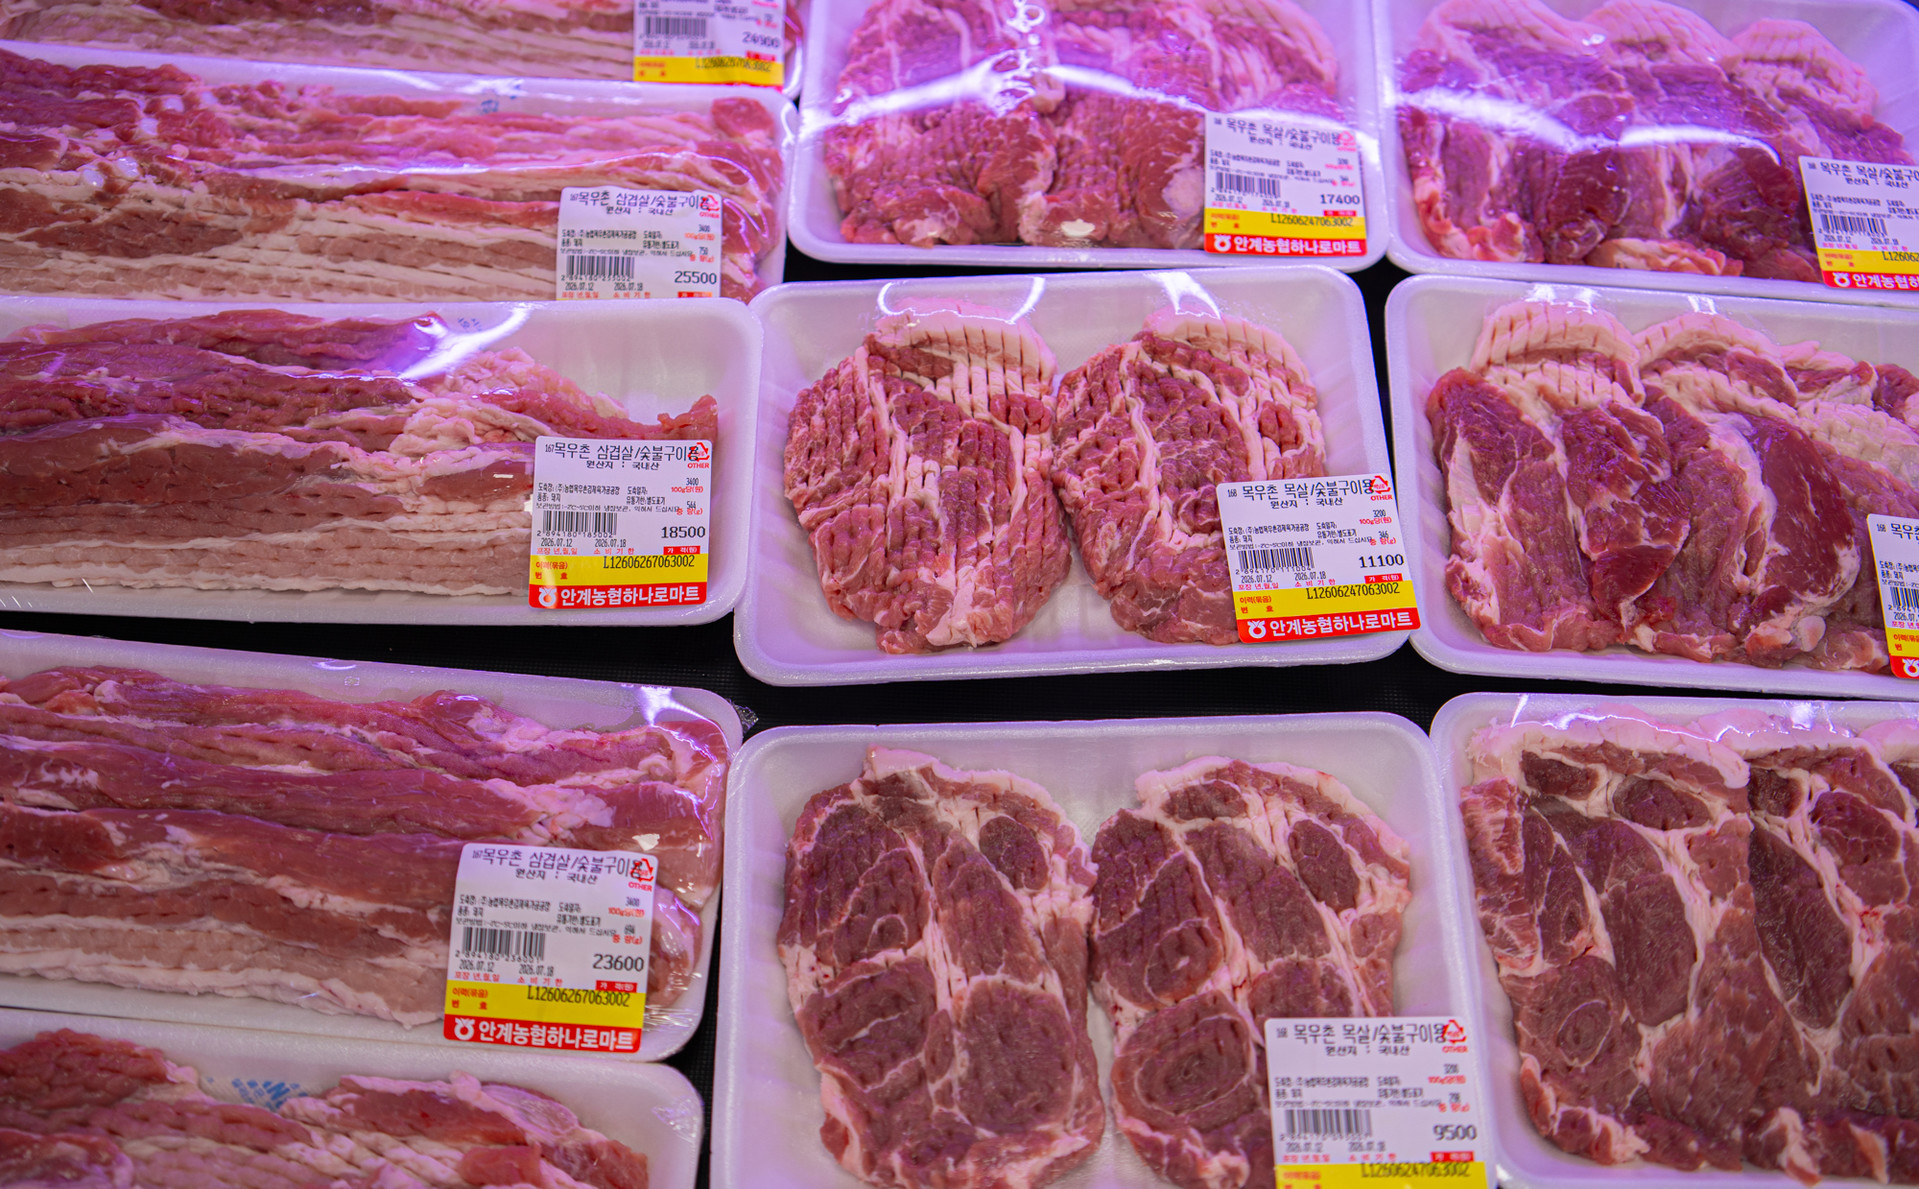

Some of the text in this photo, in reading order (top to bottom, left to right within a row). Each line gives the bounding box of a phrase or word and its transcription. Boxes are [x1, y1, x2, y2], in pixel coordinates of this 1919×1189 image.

[579, 190, 709, 210] 목우촌 삼겹살/숯불구이용
[1320, 194, 1360, 204] 17400
[1270, 213, 1354, 227] L12606247063002
[1234, 236, 1362, 254] 안계농협하나로마트
[674, 271, 717, 284] 25500
[555, 442, 590, 459] 목우촌
[597, 444, 699, 461] 삼겹살/숯불구이용
[587, 460, 613, 469] 원산지
[632, 462, 659, 470] 국내산
[686, 478, 699, 486] 3400
[1227, 479, 1374, 501] 168 목우촌 목살/숯불구이용
[1270, 500, 1298, 509] 원산지
[1316, 497, 1343, 506] 국내산
[1373, 509, 1386, 517] 3200
[661, 526, 705, 538] 18500
[541, 537, 626, 547] 2026.07.12 2026.07.18
[603, 554, 695, 569] L12606267063002
[1359, 554, 1404, 568] 11100
[1241, 571, 1326, 584] 2026.07.12 2026.07.18
[561, 586, 700, 606] 안계농협하나로마트
[1306, 582, 1400, 600] L12606247063002
[1270, 612, 1413, 637] 안계농협하나로마트
[483, 848, 522, 866] 목우촌
[529, 852, 642, 879] 삼겹살/숯불구이용
[516, 868, 597, 884] 원산지 국내산
[628, 881, 652, 892] OTHER
[459, 959, 554, 977] 2026.07.12 2026.07.18
[592, 953, 644, 972] 23600
[527, 985, 630, 1007] L12606267063002
[479, 1021, 633, 1051] 안계농협하나로마트
[1294, 1024, 1446, 1044] 목우촌 목살/숯불구이용
[1433, 1124, 1477, 1141] 9500
